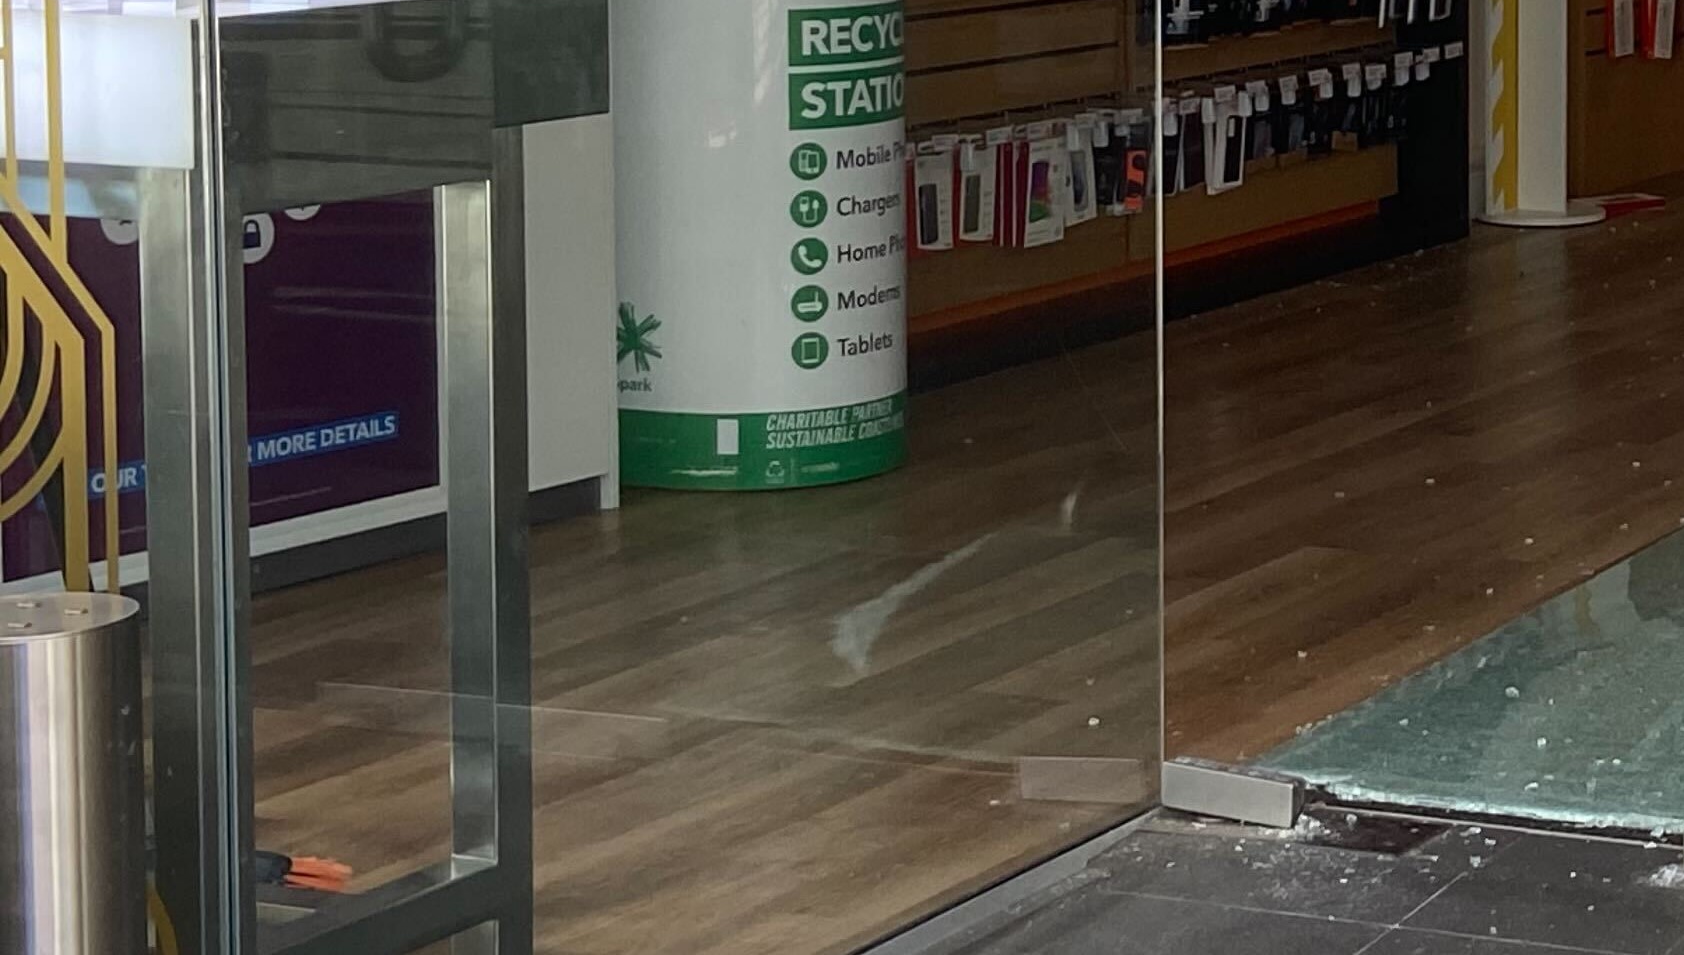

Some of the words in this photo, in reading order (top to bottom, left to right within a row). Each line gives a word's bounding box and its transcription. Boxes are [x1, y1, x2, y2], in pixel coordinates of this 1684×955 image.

[836, 145, 892, 170] Mobile
[836, 242, 886, 265] Home
[836, 285, 901, 310] Modems
[836, 330, 893, 358] Tablets
[617, 377, 652, 392] park
[766, 407, 849, 432] CHARITABLE
[256, 430, 317, 461] MORE
[319, 415, 397, 447] DETAILS
[765, 423, 855, 450] SUSTAINABLE
